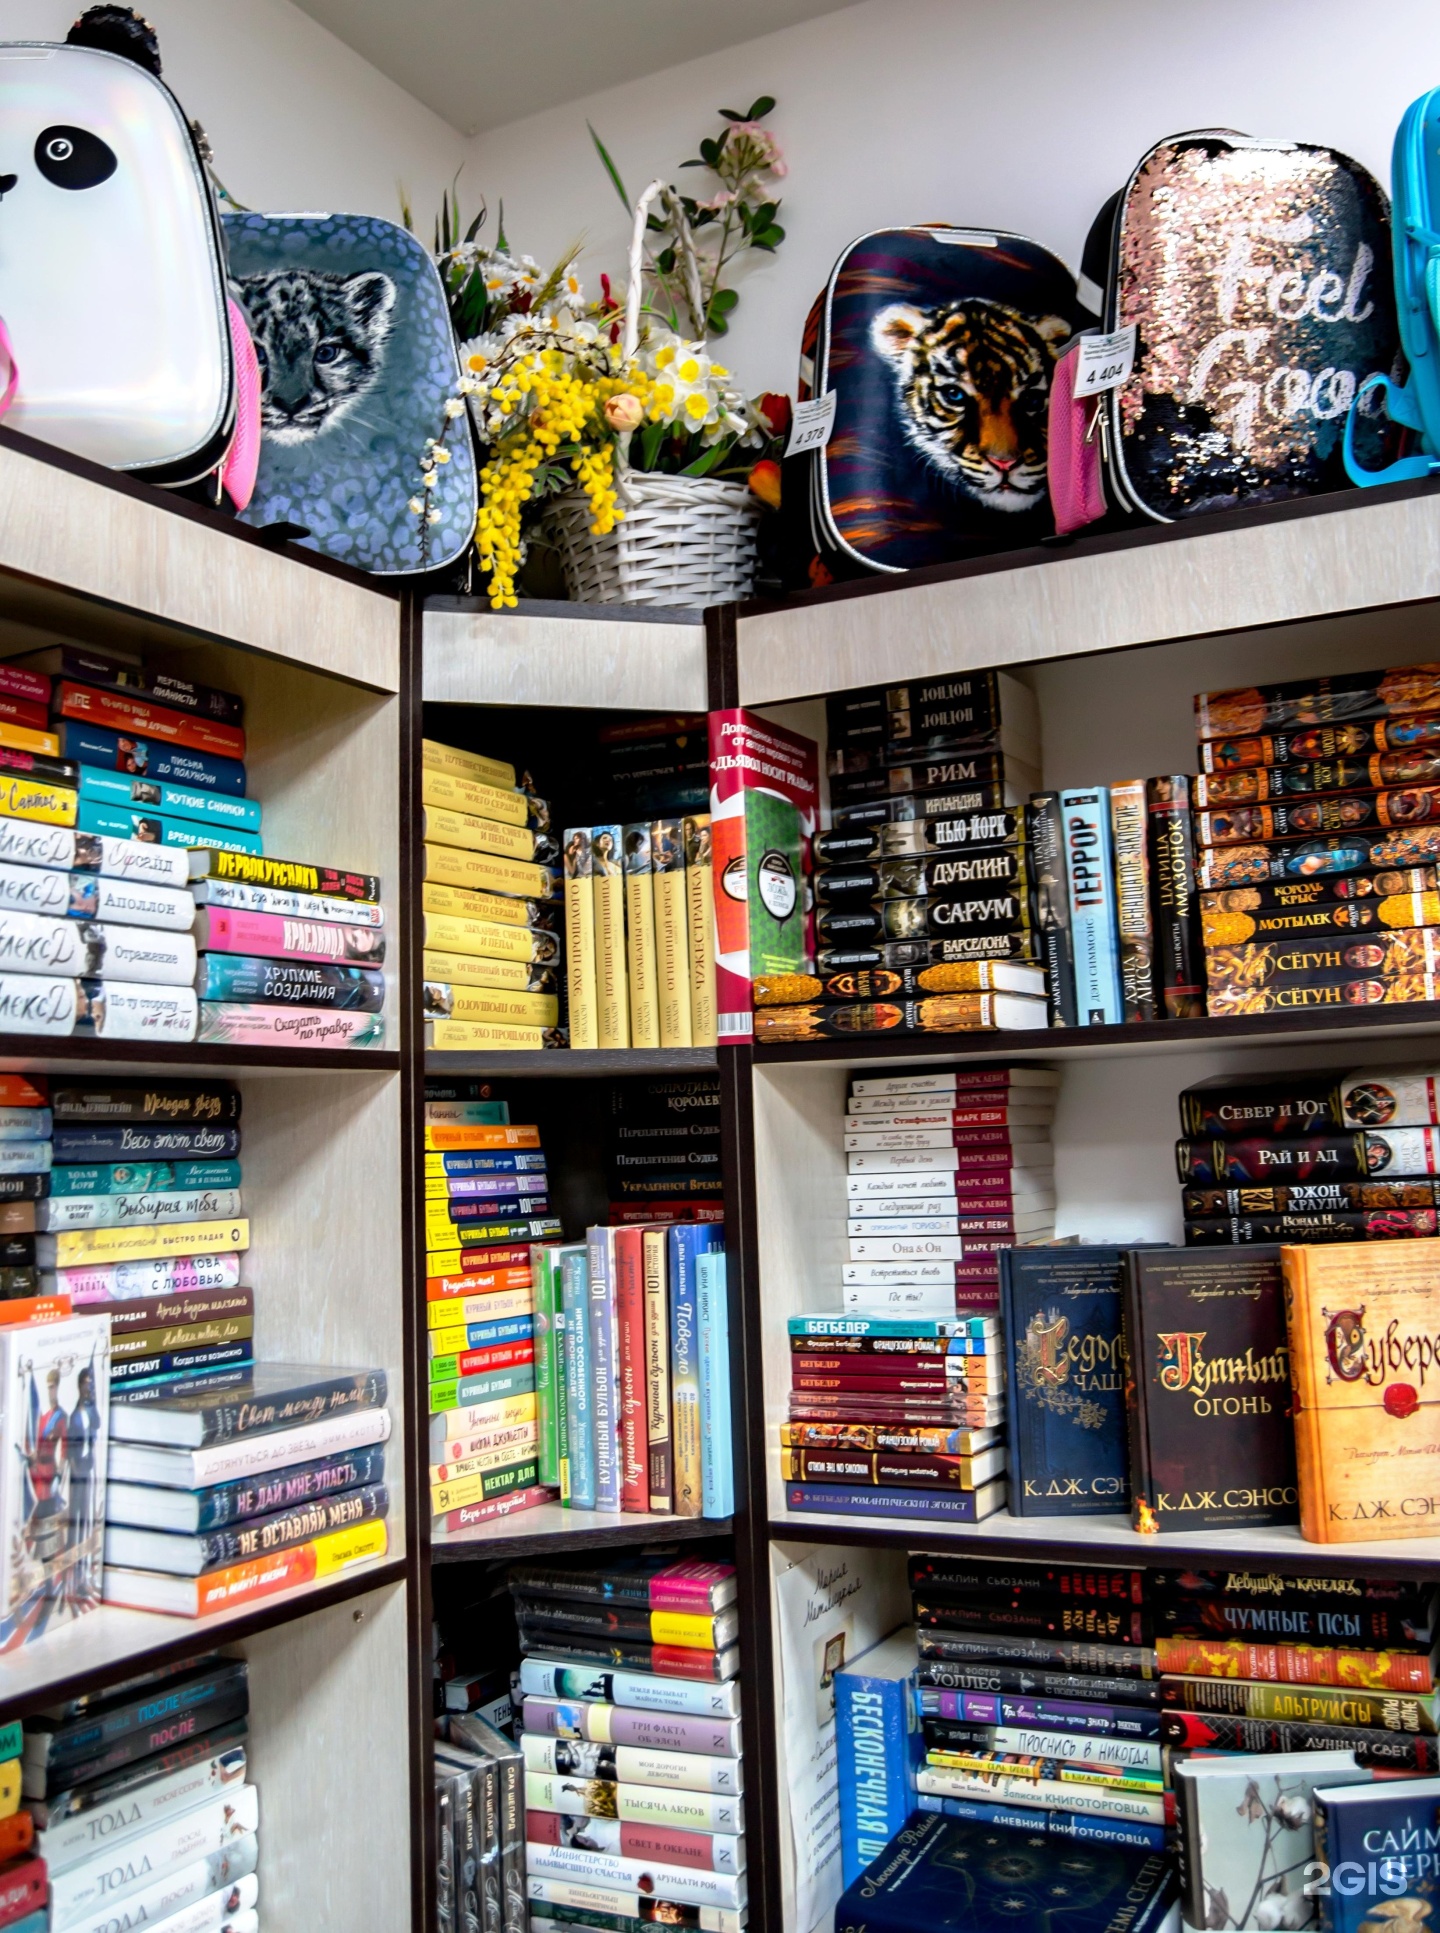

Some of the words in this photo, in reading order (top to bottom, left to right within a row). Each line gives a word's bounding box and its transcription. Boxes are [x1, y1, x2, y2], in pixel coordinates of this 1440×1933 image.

[1215, 213, 1374, 325] Feel
[1086, 370, 1098, 384] 4
[1100, 362, 1124, 381] 404
[806, 427, 824, 442] 378
[1278, 736, 1288, 762] СМИТ
[157, 763, 170, 774] ДО
[173, 766, 216, 784] ПОЛУНОЧИ
[170, 755, 204, 770] ПИСЬМА
[1274, 769, 1283, 794] СМИТ
[166, 790, 205, 809] ЖУТКИЕ
[207, 800, 245, 817] СНИМКИ
[926, 793, 982, 813] ИРЛАНДИЯ
[935, 814, 1007, 845] НЬЮ-ЙОРК
[1116, 804, 1143, 856] ЗАКЛЯТИЕ
[1278, 807, 1288, 834] СМИТ
[218, 852, 319, 890] ПЕРВОКУРСНИКИ
[1068, 816, 1105, 913] ТЕРРОР
[1156, 834, 1174, 907] ЦАРИЦА
[1169, 819, 1190, 918] АМАЗОНОК
[1117, 856, 1148, 935] ДВЕНАДЦАТОЕ
[1274, 882, 1324, 897] КОРОЛЬ
[1280, 892, 1319, 905] КРЫС
[104, 893, 176, 915] Аполлон
[570, 883, 583, 964] ПРОШЛОГО
[691, 870, 706, 990] ЧУЖЕСТРАНКА
[1258, 912, 1333, 931] МОТЫЛЕК
[283, 920, 344, 960] КРАСАВИЦА
[601, 878, 614, 997] ПУТЕШЕСТВЕННИЦА
[943, 936, 1010, 953] БАРСЕЛОНА
[1085, 918, 1099, 977] СИММОНС
[114, 945, 178, 964] Отражение
[1049, 936, 1060, 978] ХЕЛПРИН
[1276, 951, 1342, 971] СЁГУН
[264, 966, 323, 983] ХРУПКИЕ
[572, 967, 584, 997] ЭХО
[1124, 956, 1139, 1004] ДЭВИД
[1137, 957, 1153, 1003] ЛИСС
[264, 982, 336, 1000] СОЗДАНИЯ
[1053, 979, 1061, 1005] МАРК
[1091, 982, 1101, 1002] ДЭН
[1276, 986, 1342, 1006] СЁГУН
[274, 1014, 322, 1033] Сказать
[300, 1026, 314, 1040] по
[316, 1019, 353, 1041] правде
[143, 1093, 192, 1117] Мелодия
[1219, 1104, 1275, 1120] СЕВЕР
[1280, 1104, 1292, 1117] И
[1296, 1100, 1328, 1116] ЮГ
[120, 1129, 151, 1150] Весь
[154, 1133, 189, 1149] этот
[193, 1133, 226, 1150] свет
[1257, 1149, 1293, 1165] РАЙ
[1297, 1151, 1310, 1163] И
[1316, 1150, 1339, 1163] АД
[1288, 1196, 1350, 1212] КРАУЛИ
[1290, 1185, 1340, 1199] ДЖОН
[115, 1196, 181, 1219] Выбирая
[186, 1192, 219, 1213] тебя
[986, 1221, 1008, 1229] ЛЕВИ
[892, 1242, 914, 1254] Она
[916, 1243, 924, 1253] &
[925, 1242, 942, 1253] Он
[964, 1243, 988, 1251] МАРК
[155, 1261, 169, 1273] ОТ
[173, 1257, 221, 1271] ЛУКОВА
[74, 1280, 106, 1293] ЗАПАТА
[152, 1279, 159, 1290] С
[163, 1273, 224, 1289] ЛЮБОВЬЮ
[592, 1280, 606, 1300] 101
[576, 1307, 584, 1338] НИЧЕГО
[808, 1322, 870, 1334] БЕГБЕДЕР
[677, 1303, 692, 1374] Повезло
[576, 1340, 586, 1411] ОСОБЕННОГО
[800, 1360, 840, 1368] БЕГБЕДЕР
[461, 1383, 489, 1398] КУРИНЫЙ
[491, 1378, 512, 1392] БУЛЬОН
[597, 1367, 608, 1416] БУЛЬОН
[1194, 1396, 1272, 1416] ОГОНЬ
[470, 1441, 491, 1452] ШКОЛА
[493, 1427, 528, 1446] ДЖУЛЬЕТТЫ
[599, 1417, 611, 1484] КУРИНЫЙ
[238, 1490, 254, 1514] НЕ
[257, 1482, 283, 1511] ДАЙ
[286, 1476, 312, 1499] МНЕ
[313, 1464, 357, 1491] УПАСТЬ
[484, 1472, 515, 1490] НЕКТАР
[518, 1466, 535, 1483] ДЛЯ
[1158, 1493, 1176, 1511] К.
[1178, 1492, 1222, 1510] ДЖ.
[1223, 1487, 1298, 1507] СЭНСО
[240, 1531, 260, 1553] НЕ
[262, 1507, 327, 1546] ОСТАВЛЯЙ
[330, 1498, 363, 1525] МЕНЯ
[932, 1573, 979, 1584] ЖАКЛИН
[987, 1577, 1041, 1587] СЬЮЗАНН
[934, 1608, 982, 1620] ЖАКЛИН
[989, 1613, 1042, 1625] СЬЮЗАНН
[1224, 1607, 1310, 1634] ЧУМНЫЕ
[1318, 1613, 1361, 1637] ПСЫ
[941, 1643, 989, 1654] ЖАКЛИН
[997, 1647, 1050, 1660] СЬЮЗАНН
[930, 1673, 1001, 1691] УОЛЛЕС
[1044, 1676, 1088, 1688] КОРОТКИЕ
[1090, 1681, 1138, 1692] ИНТЕРВЬЮ
[138, 1694, 180, 1723] ПОСЛЕ
[1274, 1695, 1371, 1722] АЛЬТРУИСТЫ
[150, 1717, 195, 1748] ПОСЛЕ
[632, 1722, 650, 1732] ТРИ
[652, 1723, 687, 1736] ФАКТА
[638, 1734, 654, 1744] ОБ
[657, 1736, 681, 1747] ЭЛСИ
[1018, 1733, 1076, 1757] ПРОСНИСЬ
[1083, 1741, 1091, 1753] В
[1099, 1744, 1149, 1765] НИКОГДА
[1305, 1737, 1368, 1754] ЛУННЫЙ
[1371, 1743, 1409, 1757] СВЕТ
[850, 1690, 889, 1835] БЕСКОНЕЧНАЯ
[508, 1794, 516, 1831] ШЕПАРД
[624, 1799, 668, 1813] ТЫСЯЧА
[670, 1805, 705, 1817] АКРОВ
[1003, 1788, 1042, 1803] Записки
[1045, 1792, 1150, 1817] КНИГОТОРГОВЦА
[992, 1815, 1046, 1832] ДНЕВНИК
[1049, 1816, 1151, 1846] КНИГОТОРГОВЦА
[1363, 1815, 1440, 1853] САЙМ
[550, 1846, 620, 1868] МИНИСТЕРСТВО
[628, 1838, 652, 1848] СВЕТ
[655, 1842, 661, 1850] В
[663, 1843, 703, 1858] ОКЕАНЕ
[860, 1842, 914, 1900] Люсинда
[901, 1813, 939, 1849] Райли
[97, 1854, 153, 1895] ТОДД
[535, 1858, 593, 1876] НАИВЫСШЕГО
[595, 1869, 632, 1882] СЧАСТЬЯ
[656, 1874, 698, 1888] АРУНДАТИ
[700, 1880, 717, 1891] РОЙ
